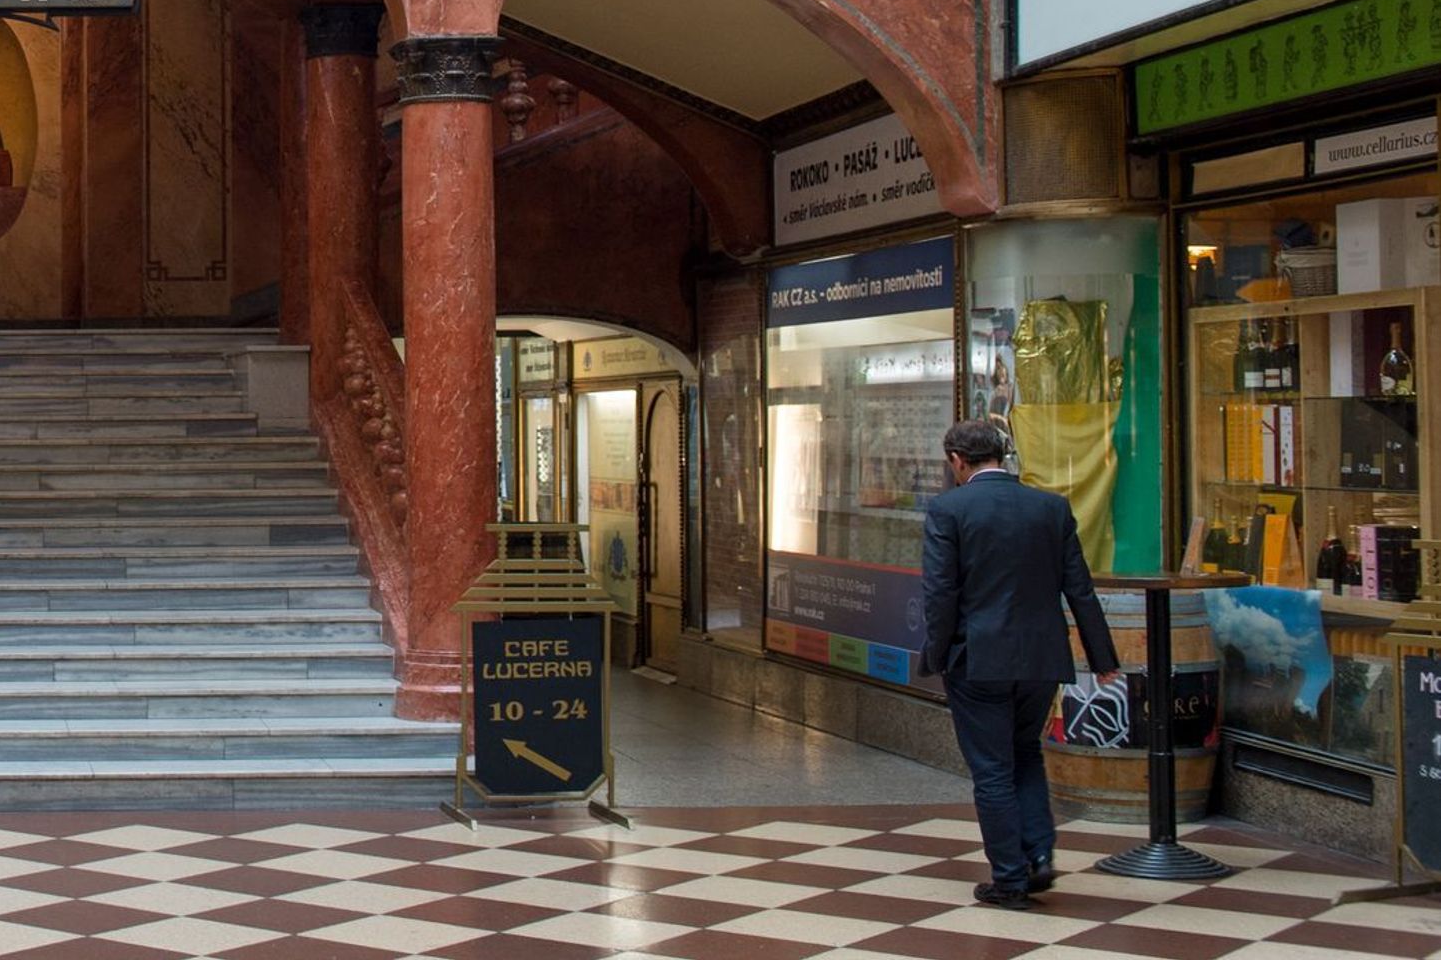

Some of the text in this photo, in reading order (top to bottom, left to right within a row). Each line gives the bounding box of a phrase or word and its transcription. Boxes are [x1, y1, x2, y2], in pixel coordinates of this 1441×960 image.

[1328, 132, 1438, 162] www.cellarius.cz
[790, 160, 829, 192] ROKOKO
[844, 142, 878, 177] PASÁŽ
[869, 280, 882, 296] na
[883, 265, 943, 292] nemovitosti
[505, 640, 570, 657] CAFE
[483, 661, 592, 679] LUCERNA
[489, 701, 525, 721] 10
[552, 699, 588, 719] 24
